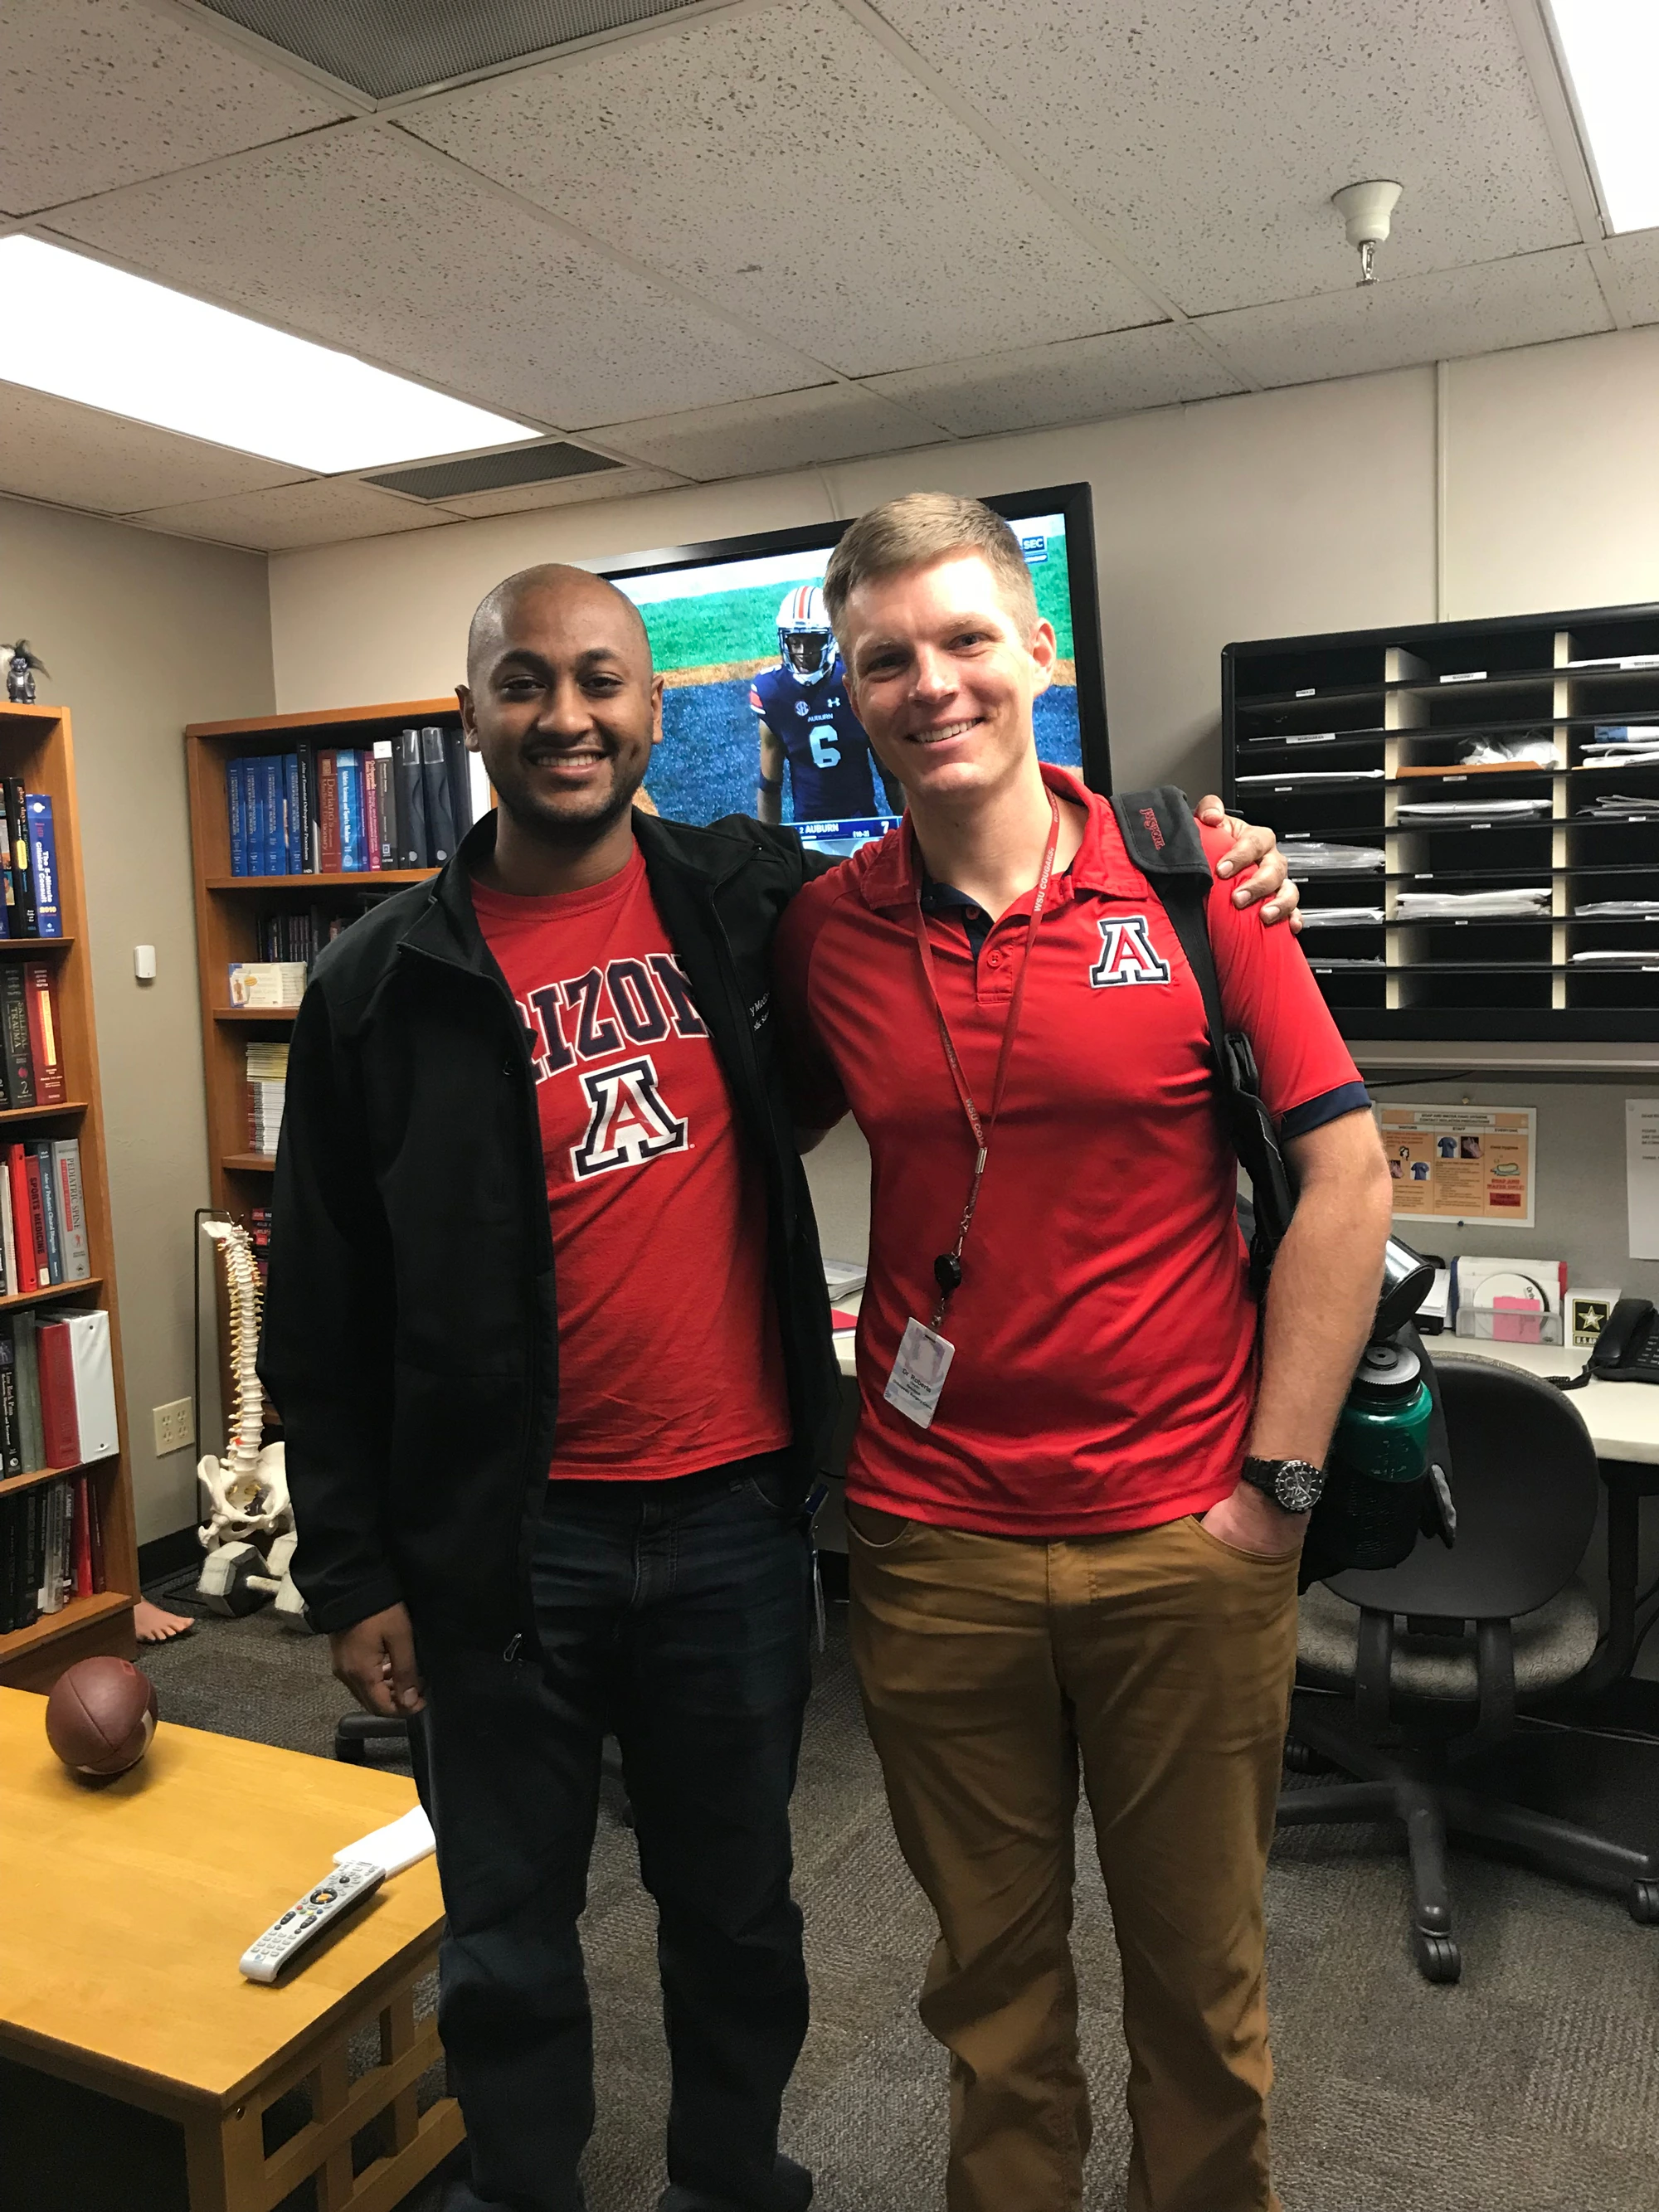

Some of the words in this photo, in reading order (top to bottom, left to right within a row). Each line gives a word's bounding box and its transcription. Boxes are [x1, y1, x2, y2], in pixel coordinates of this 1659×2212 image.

[1023, 537, 1044, 550] SEC
[807, 713, 834, 722] AUBURN
[810, 724, 842, 769] 6
[17, 786, 25, 804] glory
[327, 779, 336, 828] Dorland's
[799, 826, 805, 834] 2
[805, 823, 839, 834] AUBURN
[880, 820, 890, 834] 7
[36, 842, 44, 871] Clinical
[1039, 848, 1053, 890] COUGARS
[39, 873, 47, 903] Consult
[45, 868, 53, 902] 5-Minute
[1034, 891, 1045, 912] WSU
[1089, 915, 1171, 989] A
[11, 1006, 22, 1048] TRAUMA
[17, 1002, 27, 1049] SKELETAL
[20, 1081, 29, 1094] 2
[570, 1054, 689, 1183] A
[965, 1097, 977, 1121] WSU
[30, 1178, 40, 1210] SPORTS
[67, 1158, 78, 1203] PEDIATRIC
[72, 1205, 80, 1230] SPINE
[34, 1213, 45, 1254] MEDICINE
[902, 1368, 909, 1376] Dr
